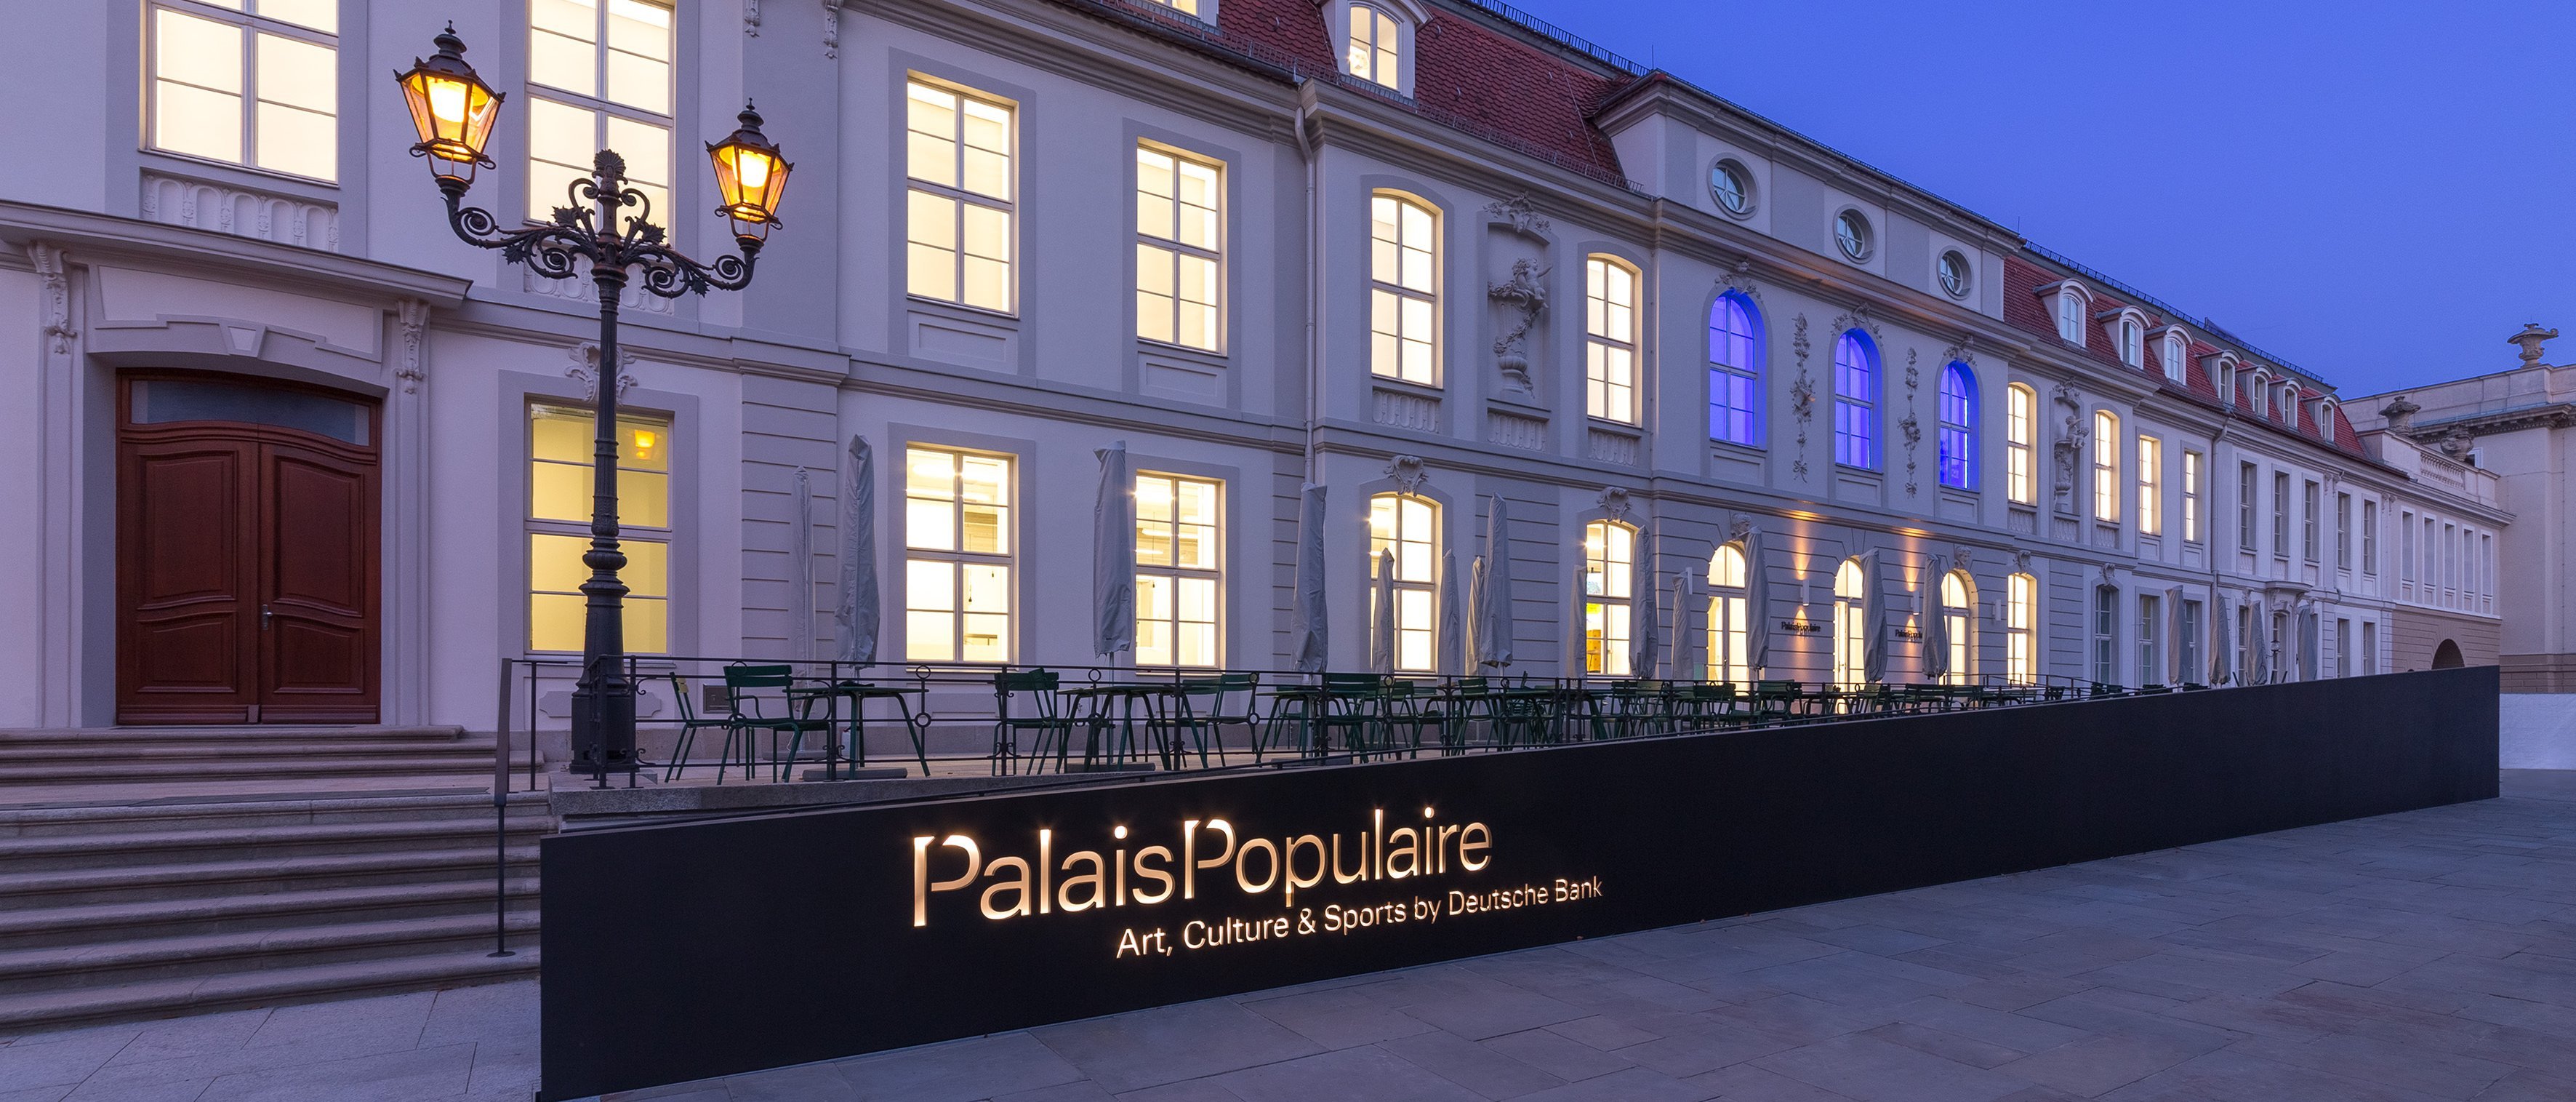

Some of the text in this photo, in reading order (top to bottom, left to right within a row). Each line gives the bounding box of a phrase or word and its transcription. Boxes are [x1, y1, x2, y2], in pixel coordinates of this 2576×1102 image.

[1895, 629, 1923, 641] PalaisPopula
[913, 807, 1493, 927] PalaisPopulaire
[1116, 875, 1604, 959] Art, Culture & Sports by Deutsche Bank
